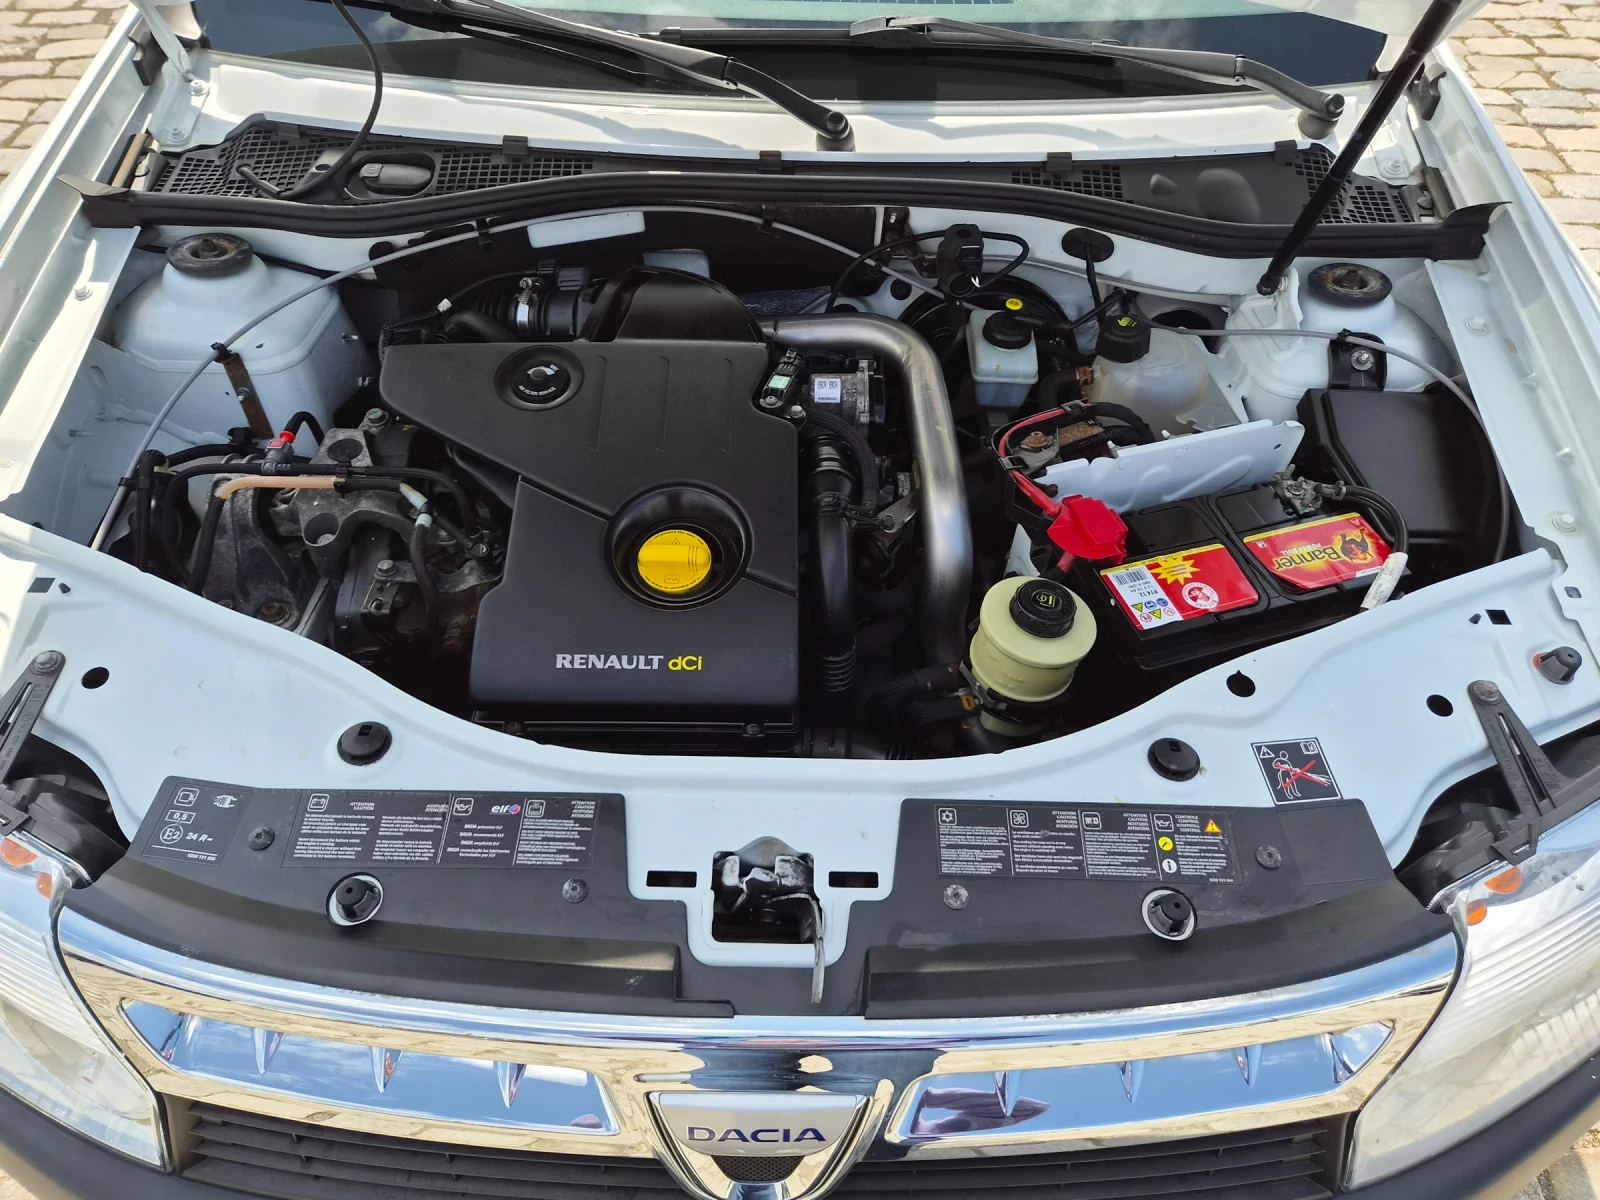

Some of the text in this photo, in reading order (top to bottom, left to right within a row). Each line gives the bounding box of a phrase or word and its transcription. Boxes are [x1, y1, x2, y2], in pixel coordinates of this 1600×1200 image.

[1274, 546, 1342, 570] Banner
[556, 654, 703, 671] RENAULT dCi
[173, 812, 187, 821] 0,5
[163, 828, 179, 840] E2
[186, 832, 197, 840] 24
[687, 1126, 827, 1142] DACIA
